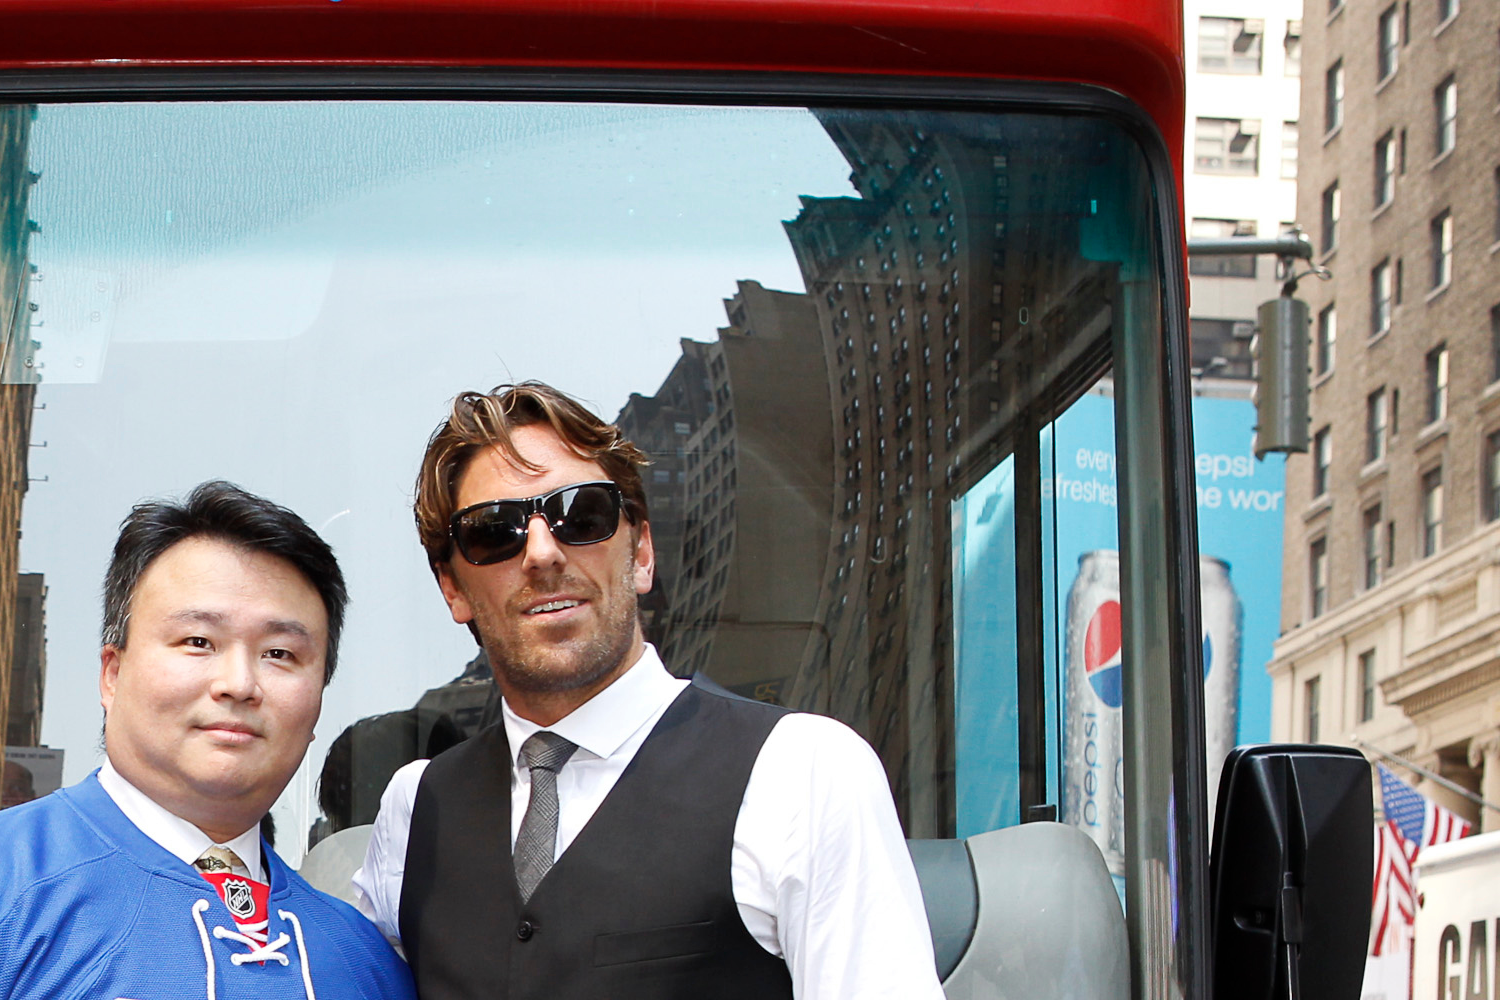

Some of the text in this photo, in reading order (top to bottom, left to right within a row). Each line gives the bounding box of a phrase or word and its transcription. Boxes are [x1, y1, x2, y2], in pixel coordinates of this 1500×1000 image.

[1195, 453, 1255, 481] epsi
[1227, 488, 1285, 512] wor
[1082, 712, 1102, 828] pepsi
